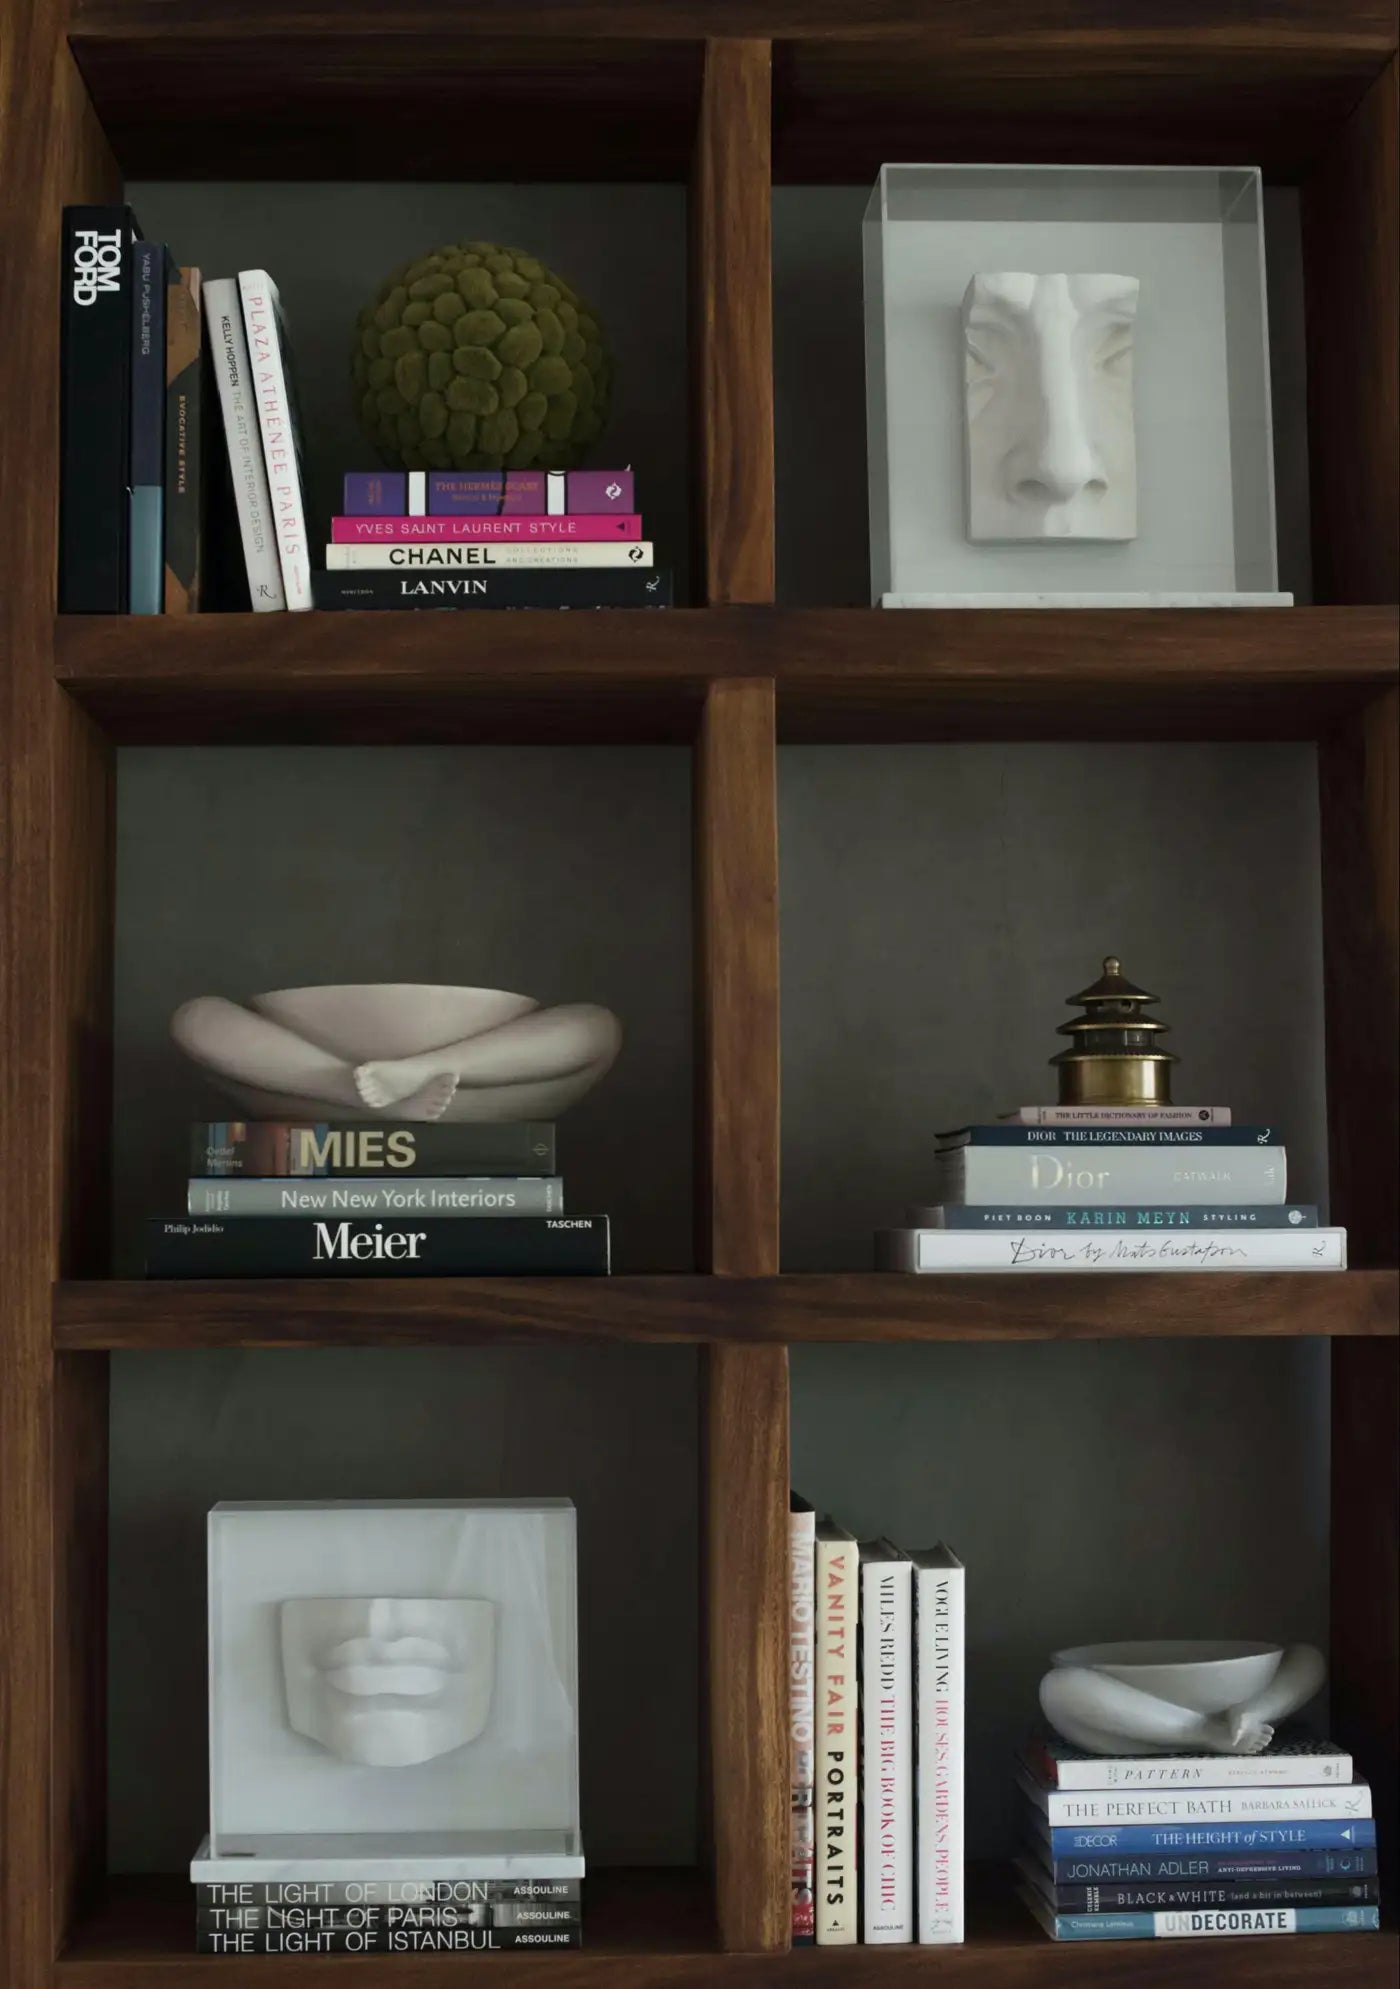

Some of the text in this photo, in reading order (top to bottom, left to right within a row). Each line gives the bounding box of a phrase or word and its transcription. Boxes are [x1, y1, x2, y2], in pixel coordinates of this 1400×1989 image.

[74, 231, 98, 306] FORD
[98, 229, 121, 291] TOM
[141, 253, 151, 281] YABU
[221, 315, 265, 553] KELLY HOPPEN THE ART OF INTERIOR DESIGN
[249, 297, 271, 362] PLAZA
[277, 486, 300, 554] PARIS
[178, 394, 187, 495] EVOCATIVE STYLE
[355, 521, 577, 535] YVES SAINT LAURENT STYLE
[389, 548, 496, 565] CHANEL
[400, 580, 488, 595] LANVIN
[1055, 1111, 1070, 1119] THE
[1071, 1111, 1098, 1120] LITTLE
[1027, 1130, 1202, 1142] DIOR THE LEGENDARY IMAGES
[300, 1130, 417, 1168] MIES
[1030, 1154, 1110, 1190] Dior
[281, 1188, 517, 1209] New New York Interiors
[546, 1220, 593, 1229] TASCHEN
[983, 1213, 1052, 1222] PIET BOON
[1066, 1210, 1192, 1225] KARIN MEYN
[1202, 1213, 1257, 1222] STYLING
[164, 1223, 190, 1236] Philip
[312, 1222, 428, 1260] Meier
[827, 1555, 845, 1659] VANITY
[935, 1581, 949, 1633] VOGUE
[935, 1638, 949, 1692] LIVING
[790, 1625, 814, 1742] TESTINO
[827, 1674, 845, 1736] FAIR
[880, 1576, 895, 1911] MILES REDD THE BIG BOOK OF CHIC
[1124, 1768, 1203, 1780] PATTERN
[1063, 1803, 1099, 1817] THE
[1107, 1801, 1178, 1815] PERFECT
[1187, 1799, 1232, 1814] BATH
[1241, 1800, 1290, 1810] BARBARA
[827, 1751, 844, 1905] PORTRAITS
[1152, 1829, 1307, 1846] THE HEIGHT of STYLE
[935, 1849, 949, 1912] PEOPLE
[1066, 1860, 1209, 1878] JONATHAN ADLER
[206, 1881, 569, 1904] THE LIGHT OF LONDON ASSOULINE
[209, 1906, 570, 1929] THE LIGHT OF PARIS ASSOULINE
[1164, 1911, 1289, 1931] UNDECORATE
[208, 1929, 570, 1952] THE LIGHT OF ISTANBUL ASSOULINE
